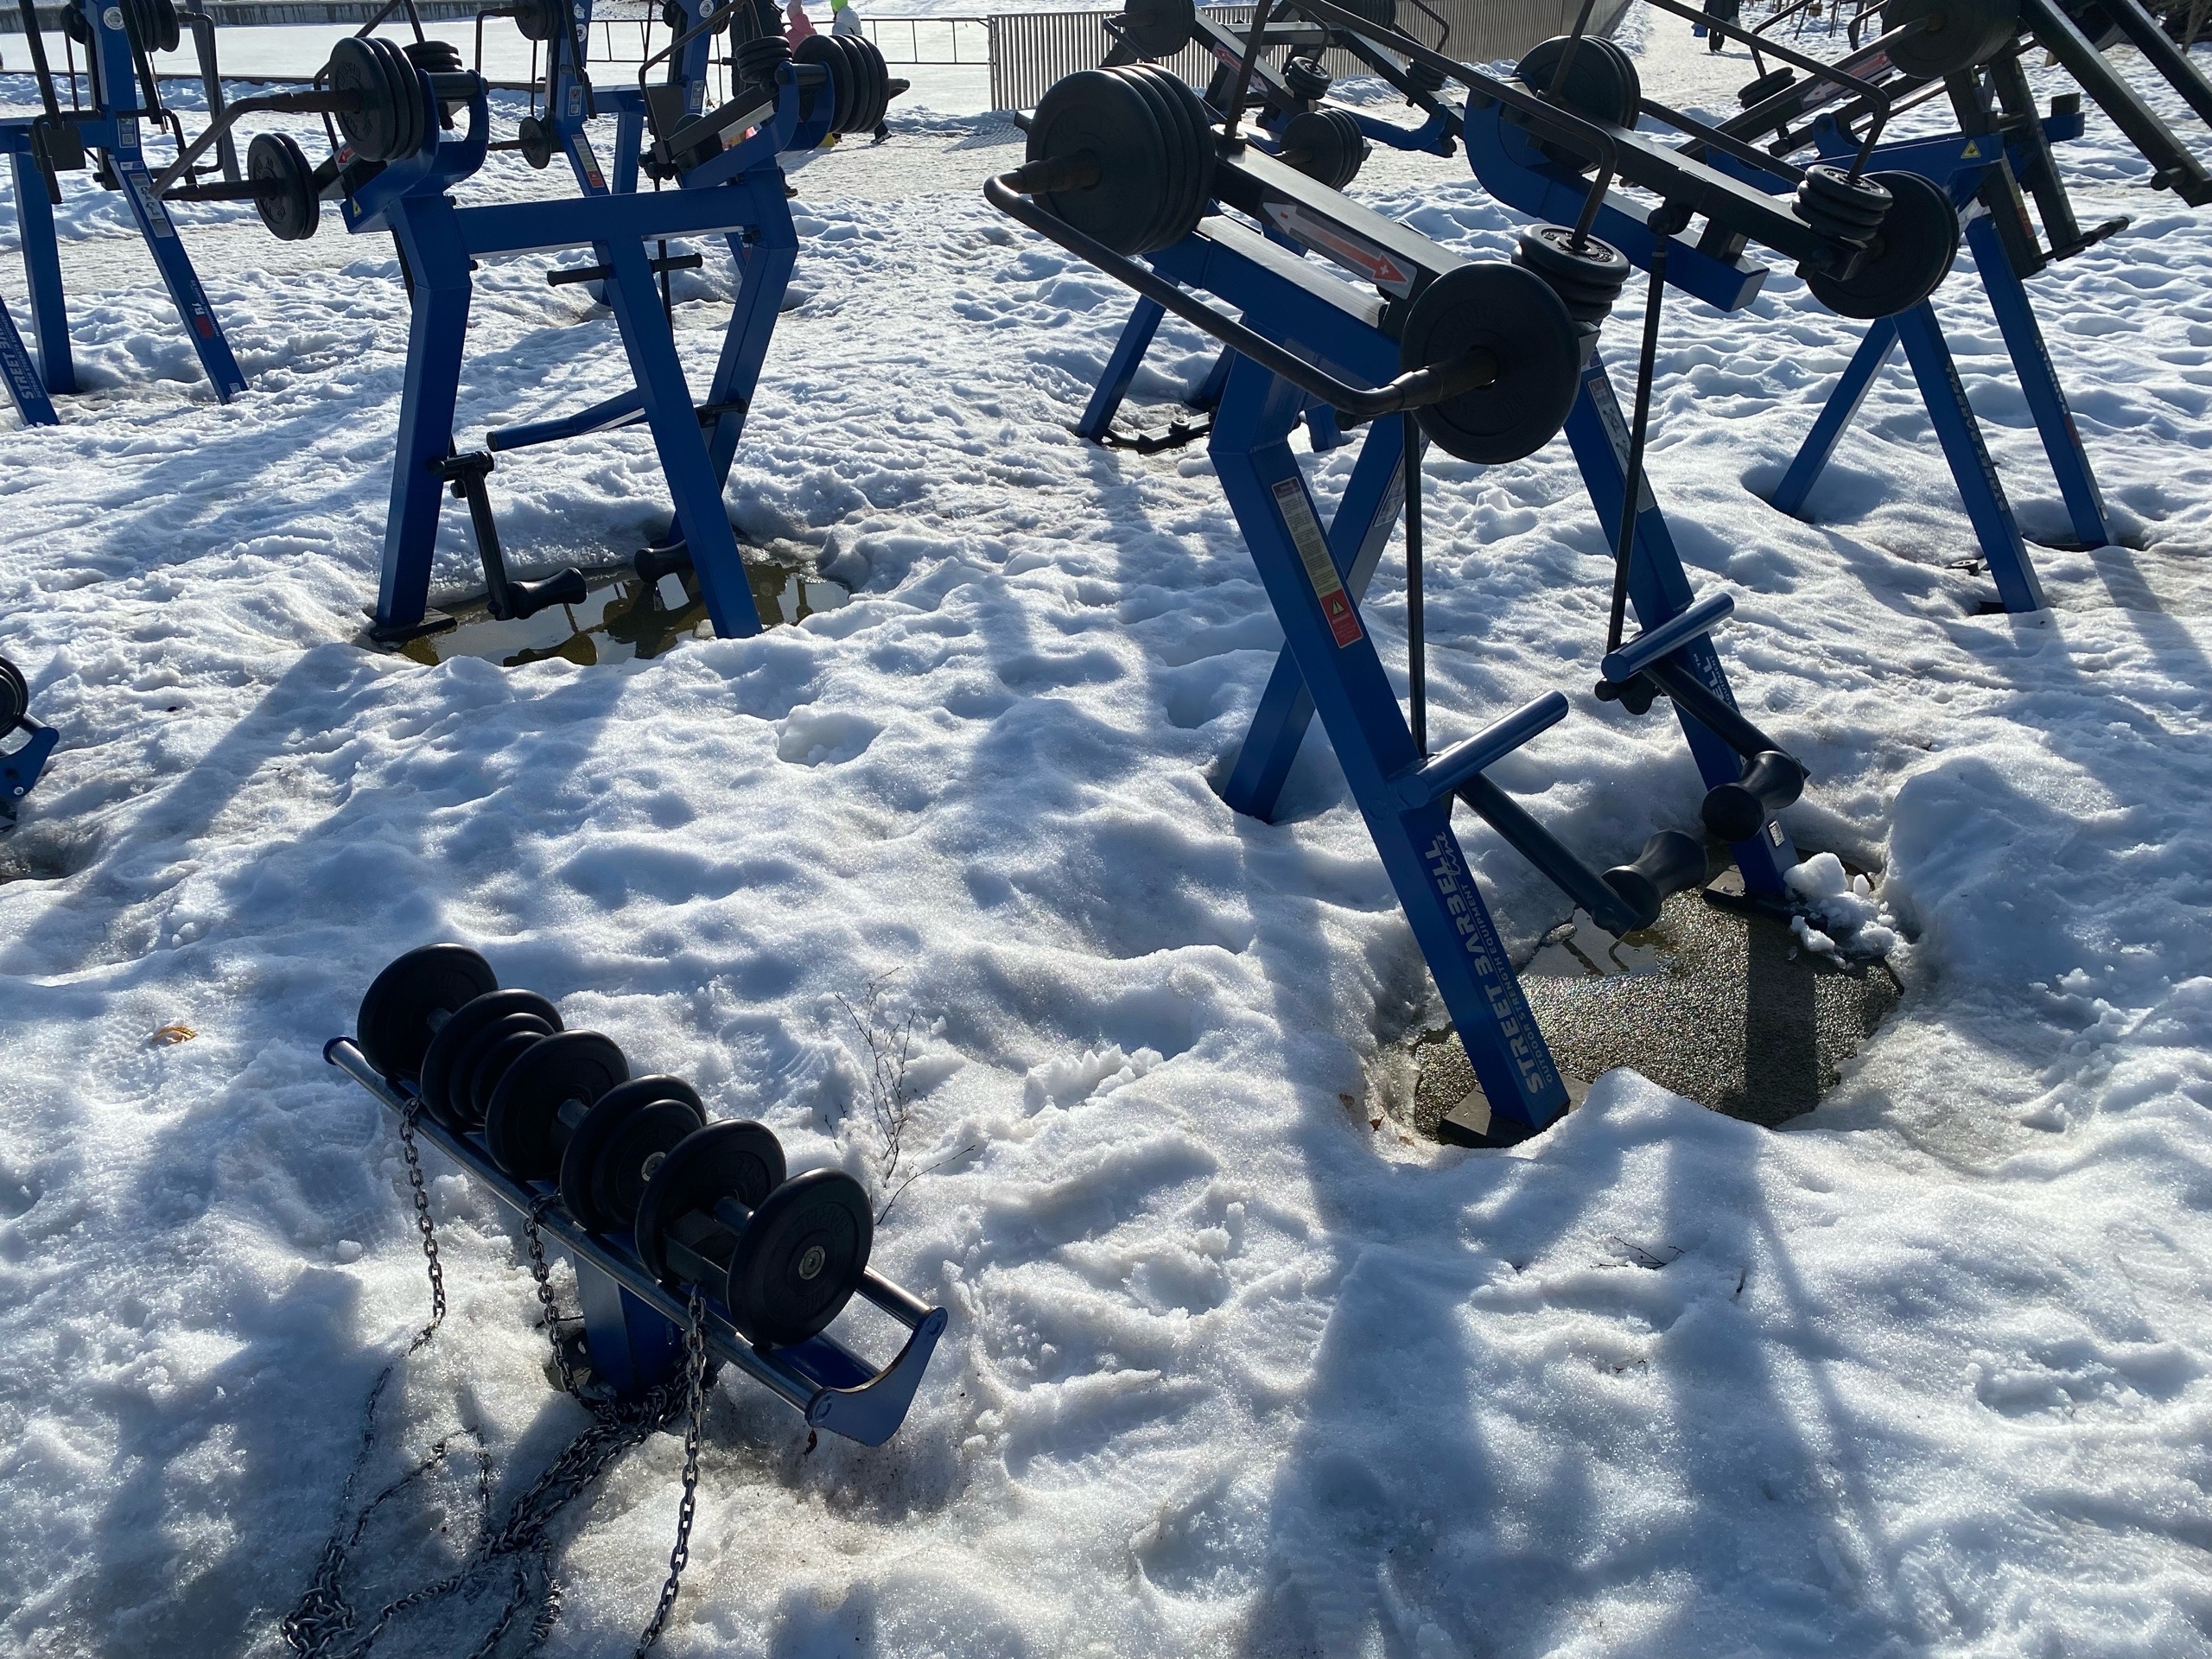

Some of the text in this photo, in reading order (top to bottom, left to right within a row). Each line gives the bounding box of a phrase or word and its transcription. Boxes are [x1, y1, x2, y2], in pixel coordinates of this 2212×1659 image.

[3, 351, 35, 400] STREET
[1977, 446, 2009, 512] STREET
[1424, 839, 1545, 1095] STREET BARBELL
[1460, 883, 1554, 1084] OUTDOOR STRENGTH EQUIPMENT
